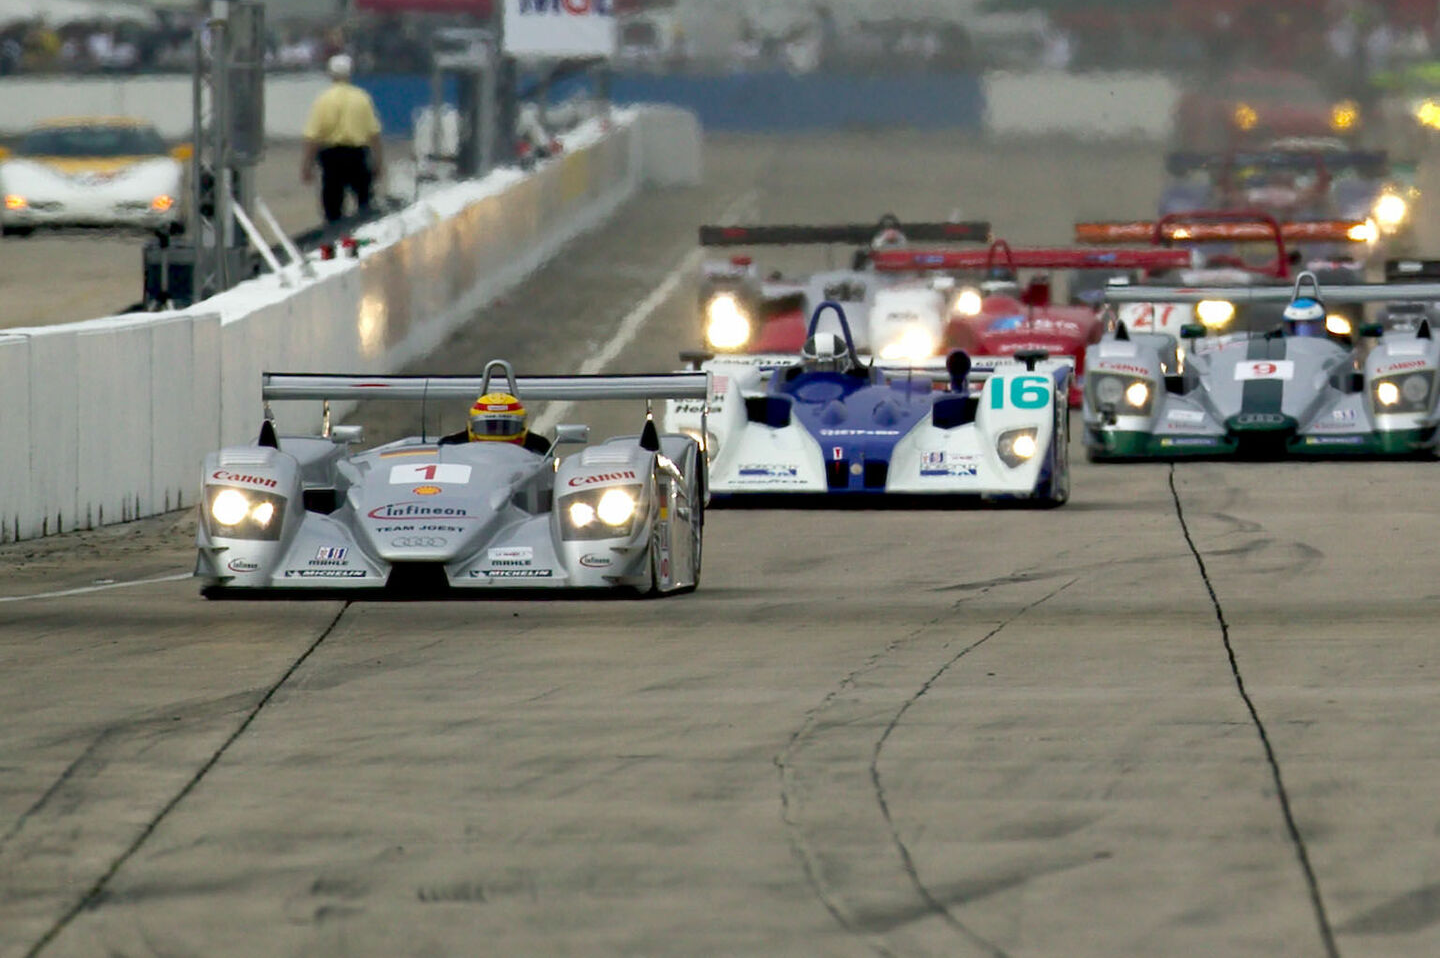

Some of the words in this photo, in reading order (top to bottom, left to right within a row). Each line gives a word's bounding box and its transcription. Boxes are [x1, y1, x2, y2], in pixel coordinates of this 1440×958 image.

[1252, 363, 1277, 375] 9
[990, 376, 1050, 409] 16
[212, 470, 278, 488] Canon
[415, 465, 437, 480] 1
[568, 470, 636, 487] Canon
[376, 525, 414, 533] TEAM
[418, 524, 465, 533] JOEST
